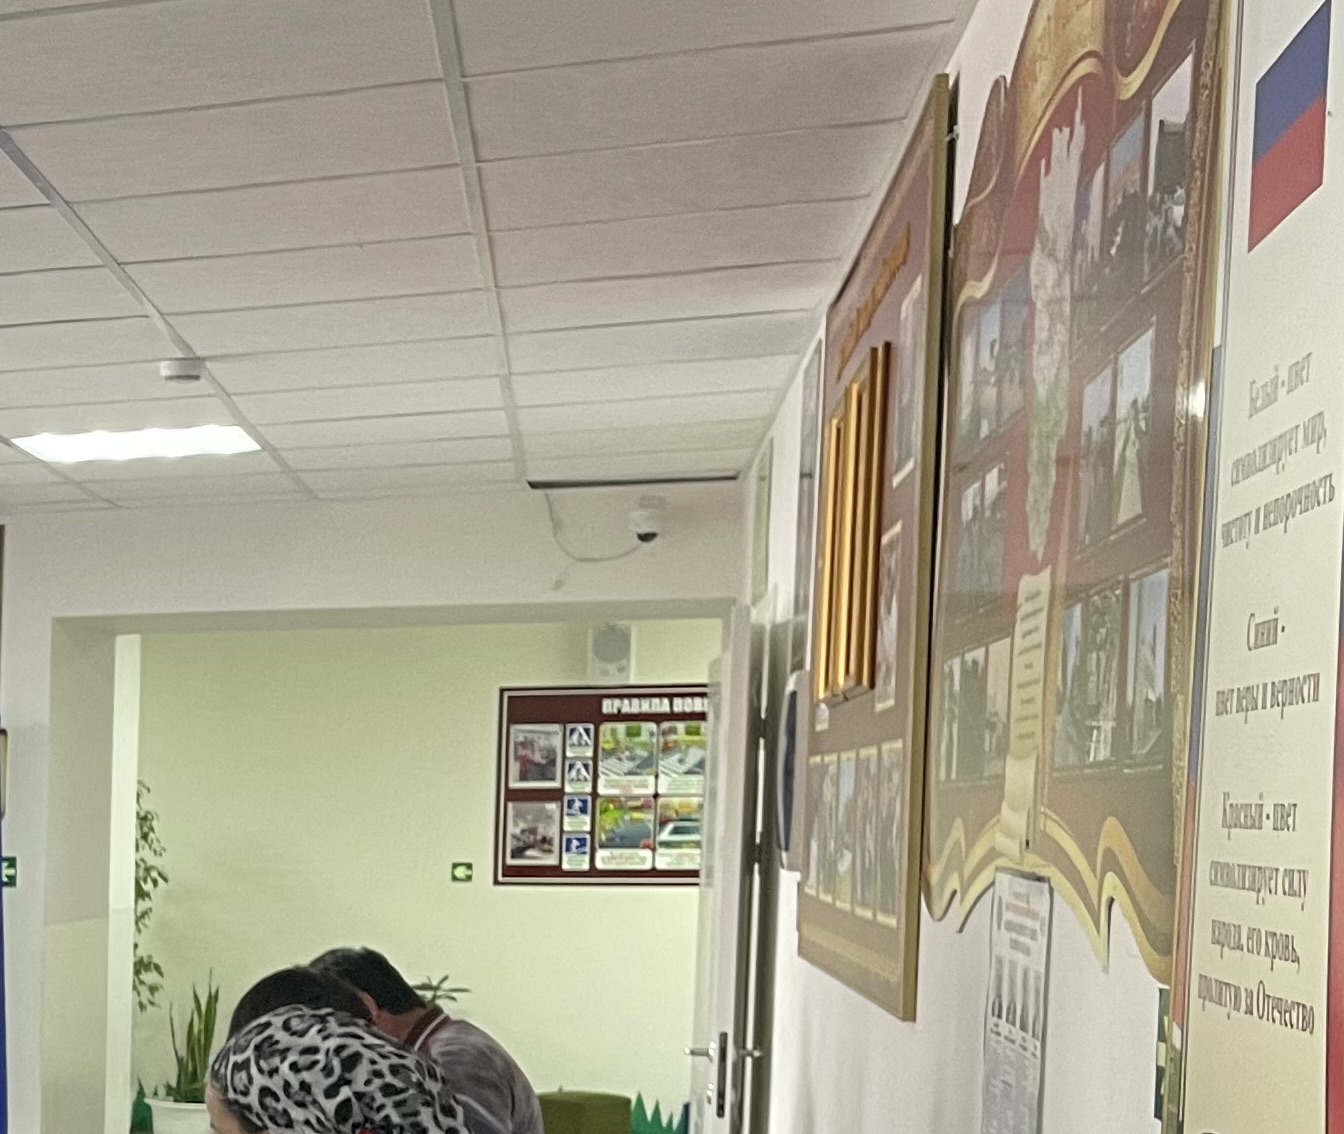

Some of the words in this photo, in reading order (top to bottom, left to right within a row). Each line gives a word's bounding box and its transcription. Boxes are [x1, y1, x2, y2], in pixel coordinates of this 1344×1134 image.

[1254, 507, 1261, 534] и
[1263, 473, 1335, 533] непорочность
[1247, 605, 1279, 651] Синий
[602, 697, 670, 714] ПРАВИЛА
[1236, 683, 1258, 724] веры
[1262, 683, 1268, 709] и
[1270, 673, 1320, 719] верности
[1222, 791, 1263, 839] Красный
[1273, 802, 1297, 832] цвет
[1209, 859, 1279, 904] символизирует
[1282, 868, 1308, 911] силу
[1247, 925, 1261, 955] его
[1265, 931, 1300, 973] кровь,
[1198, 973, 1241, 1019] пролитую
[1244, 987, 1254, 1017] за
[1257, 980, 1314, 1034] Отечество
